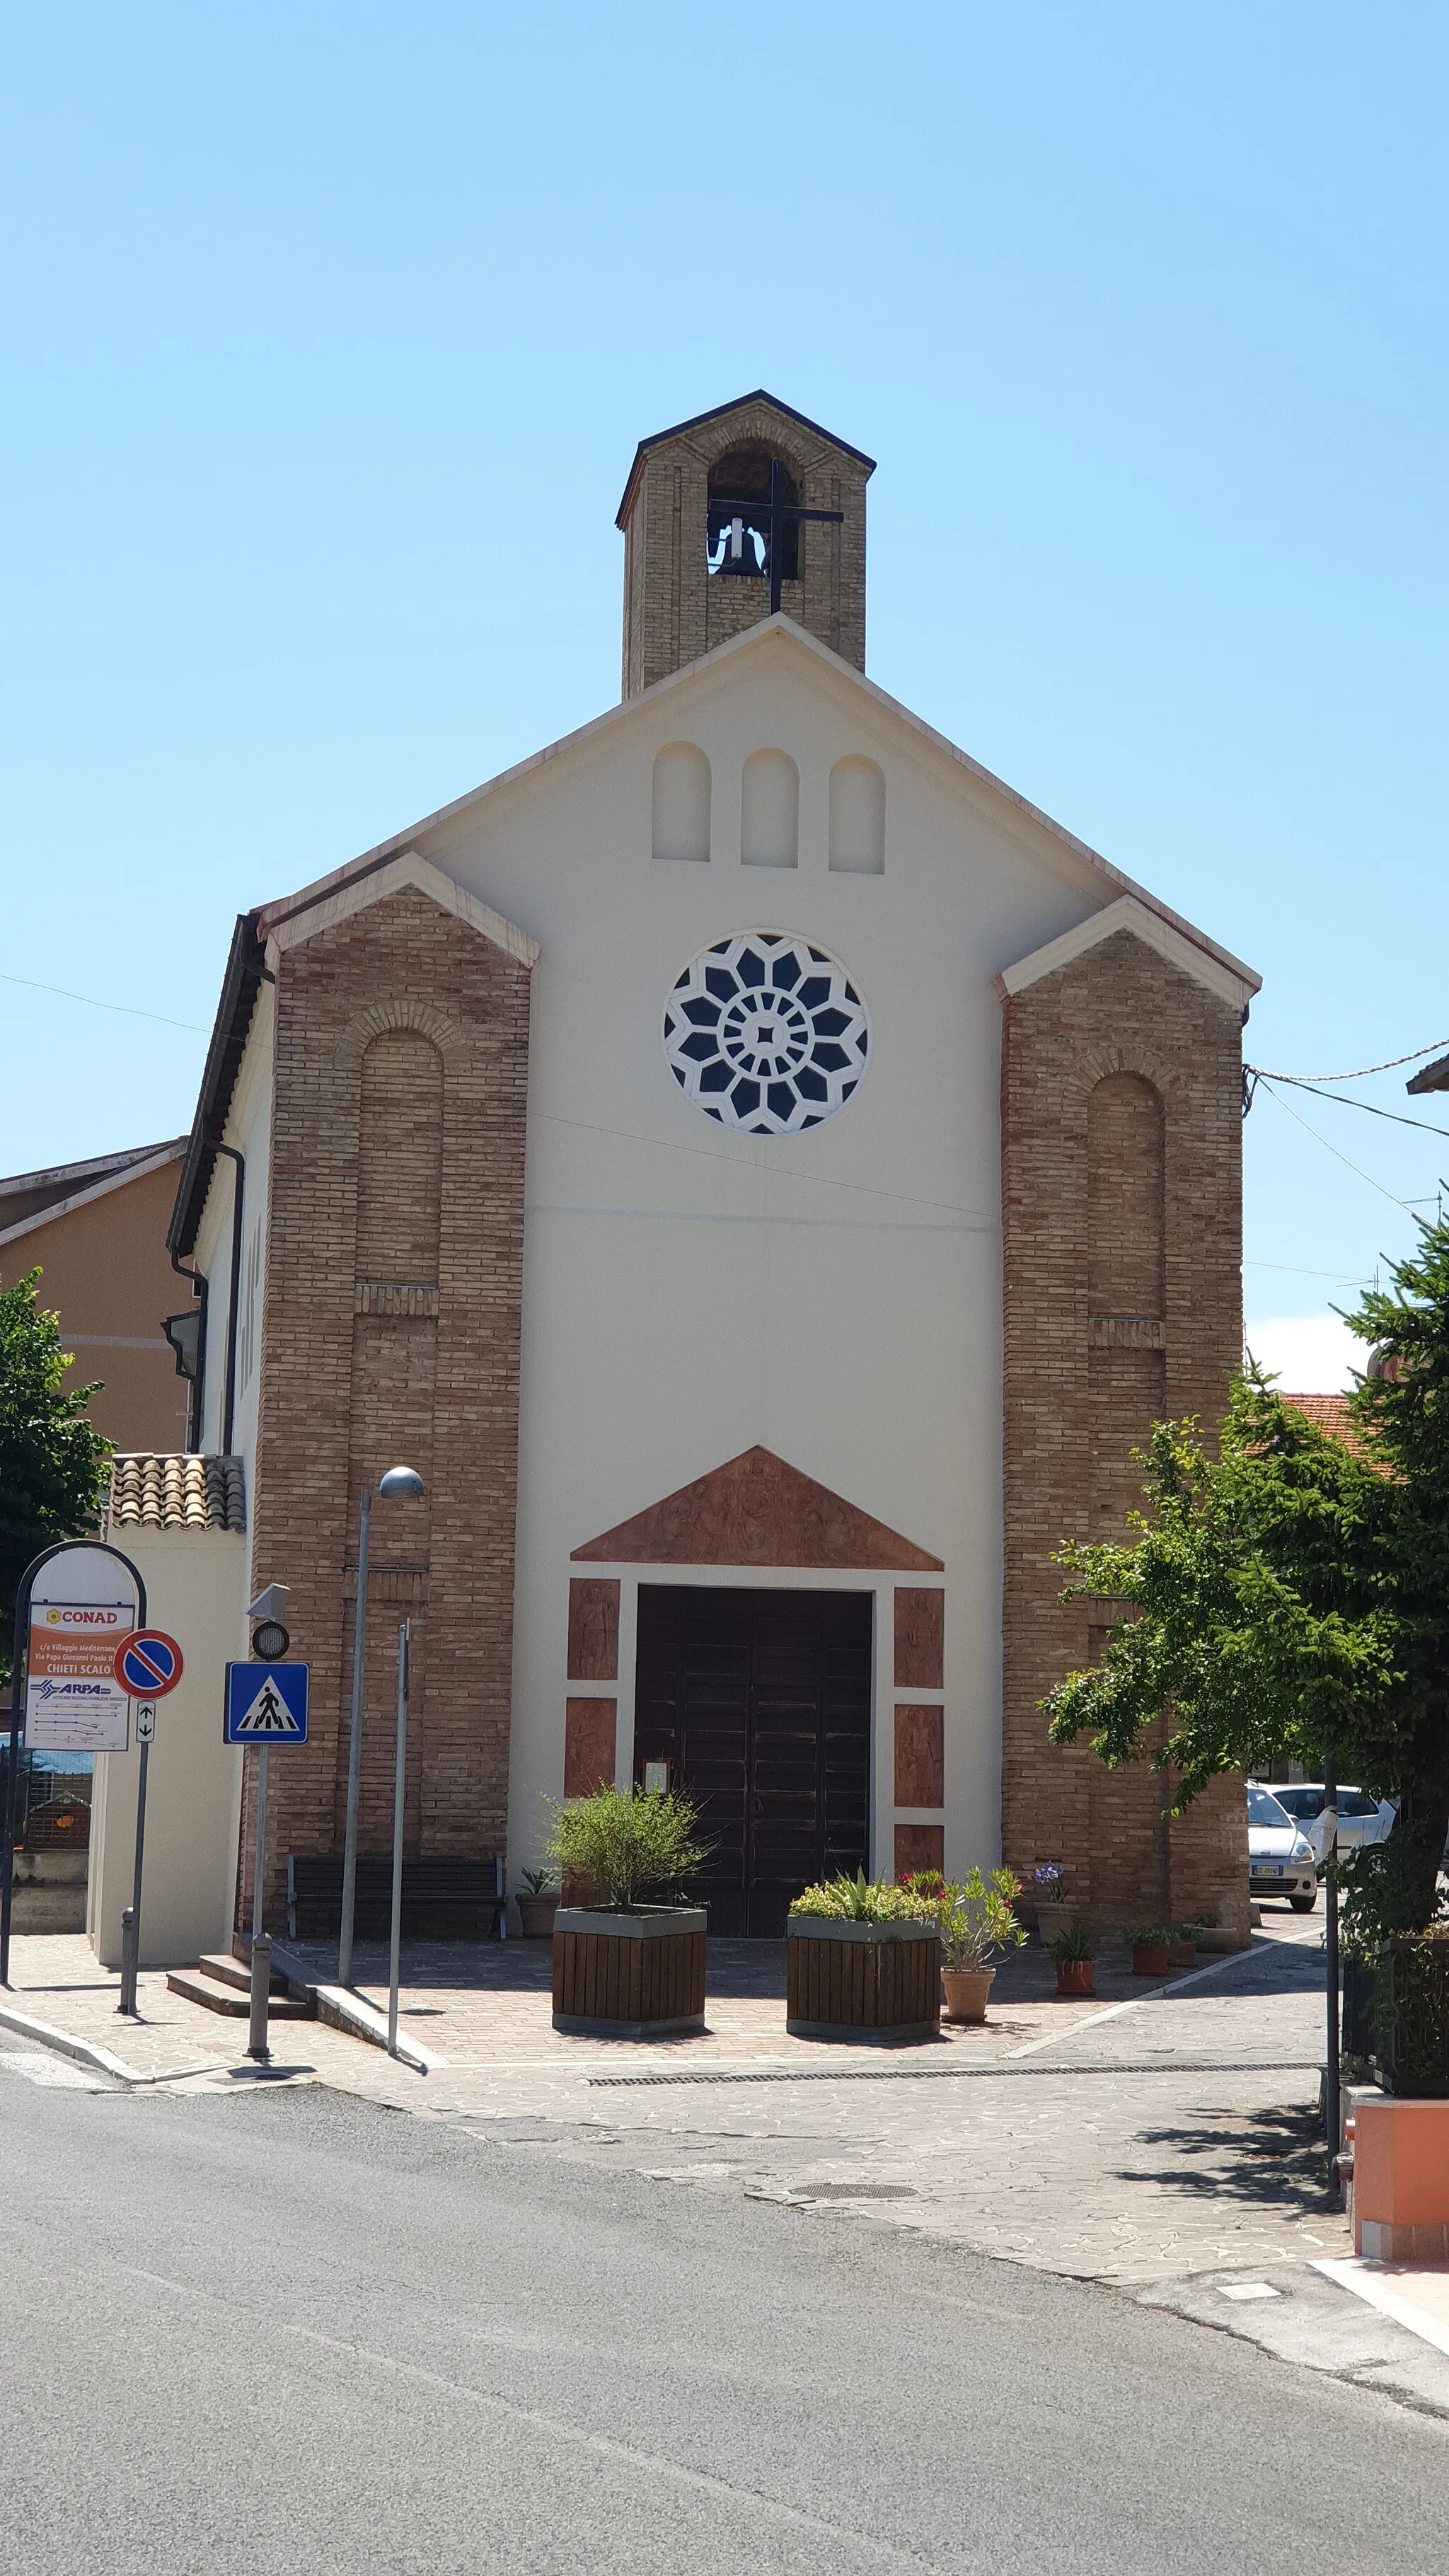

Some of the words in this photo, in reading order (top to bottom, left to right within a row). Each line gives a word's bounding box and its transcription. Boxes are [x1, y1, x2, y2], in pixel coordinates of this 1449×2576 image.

[62, 1611, 117, 1624] CONAD
[52, 1644, 78, 1653] Villaggio
[46, 1653, 61, 1662] Papa
[47, 1663, 77, 1673] CHIETI
[80, 1665, 111, 1675] SCALO
[58, 1683, 100, 1694] ARPA
